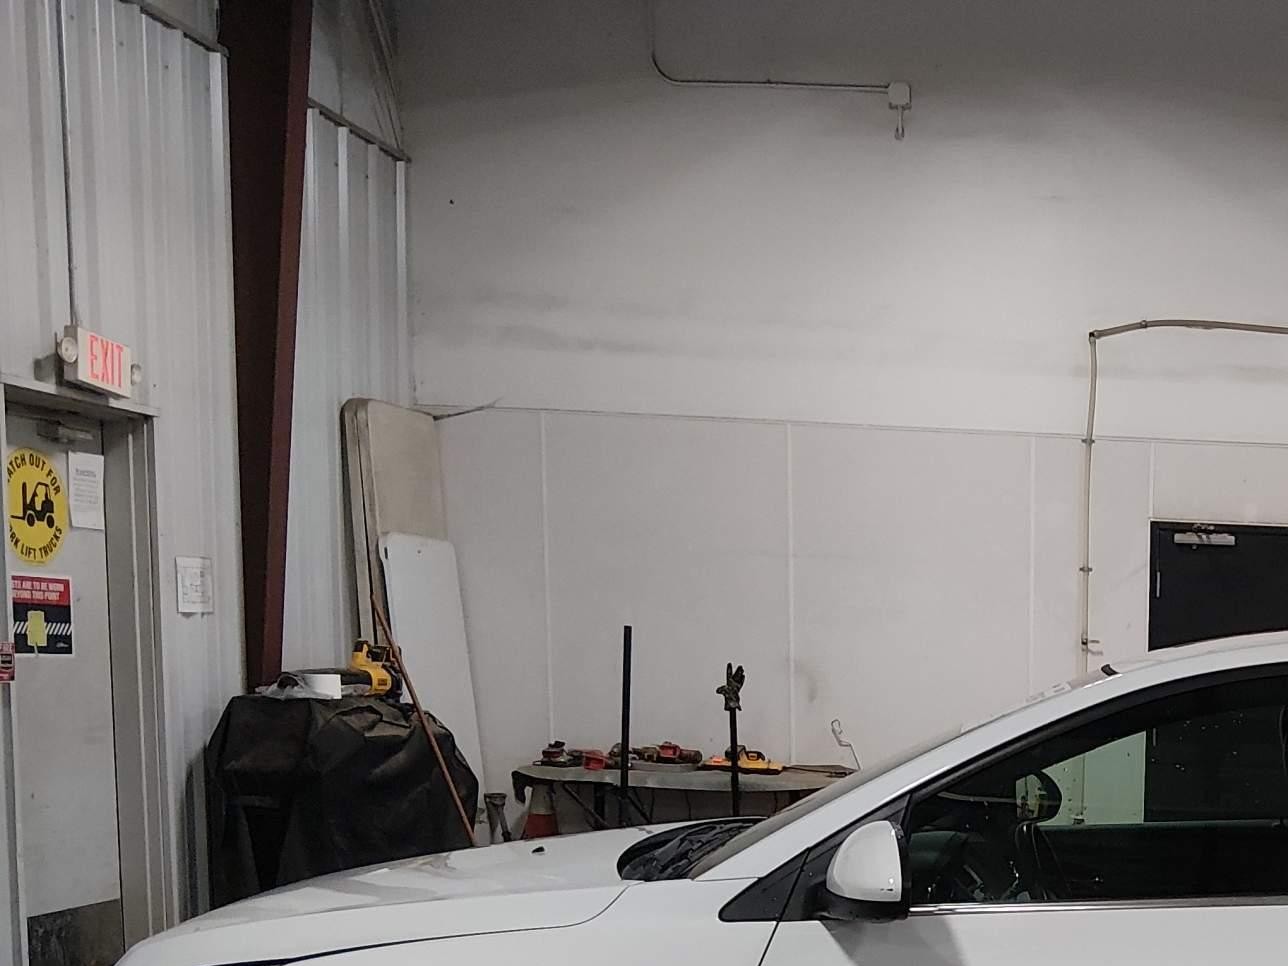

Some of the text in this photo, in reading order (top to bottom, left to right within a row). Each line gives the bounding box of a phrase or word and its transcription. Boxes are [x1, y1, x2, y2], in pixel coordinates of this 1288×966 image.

[89, 334, 123, 389] EXIT
[7, 453, 27, 483] ATCH
[29, 453, 46, 472] OUT
[46, 468, 61, 496] FOR
[20, 543, 36, 560] LIFT
[38, 525, 62, 559] TRUCKS
